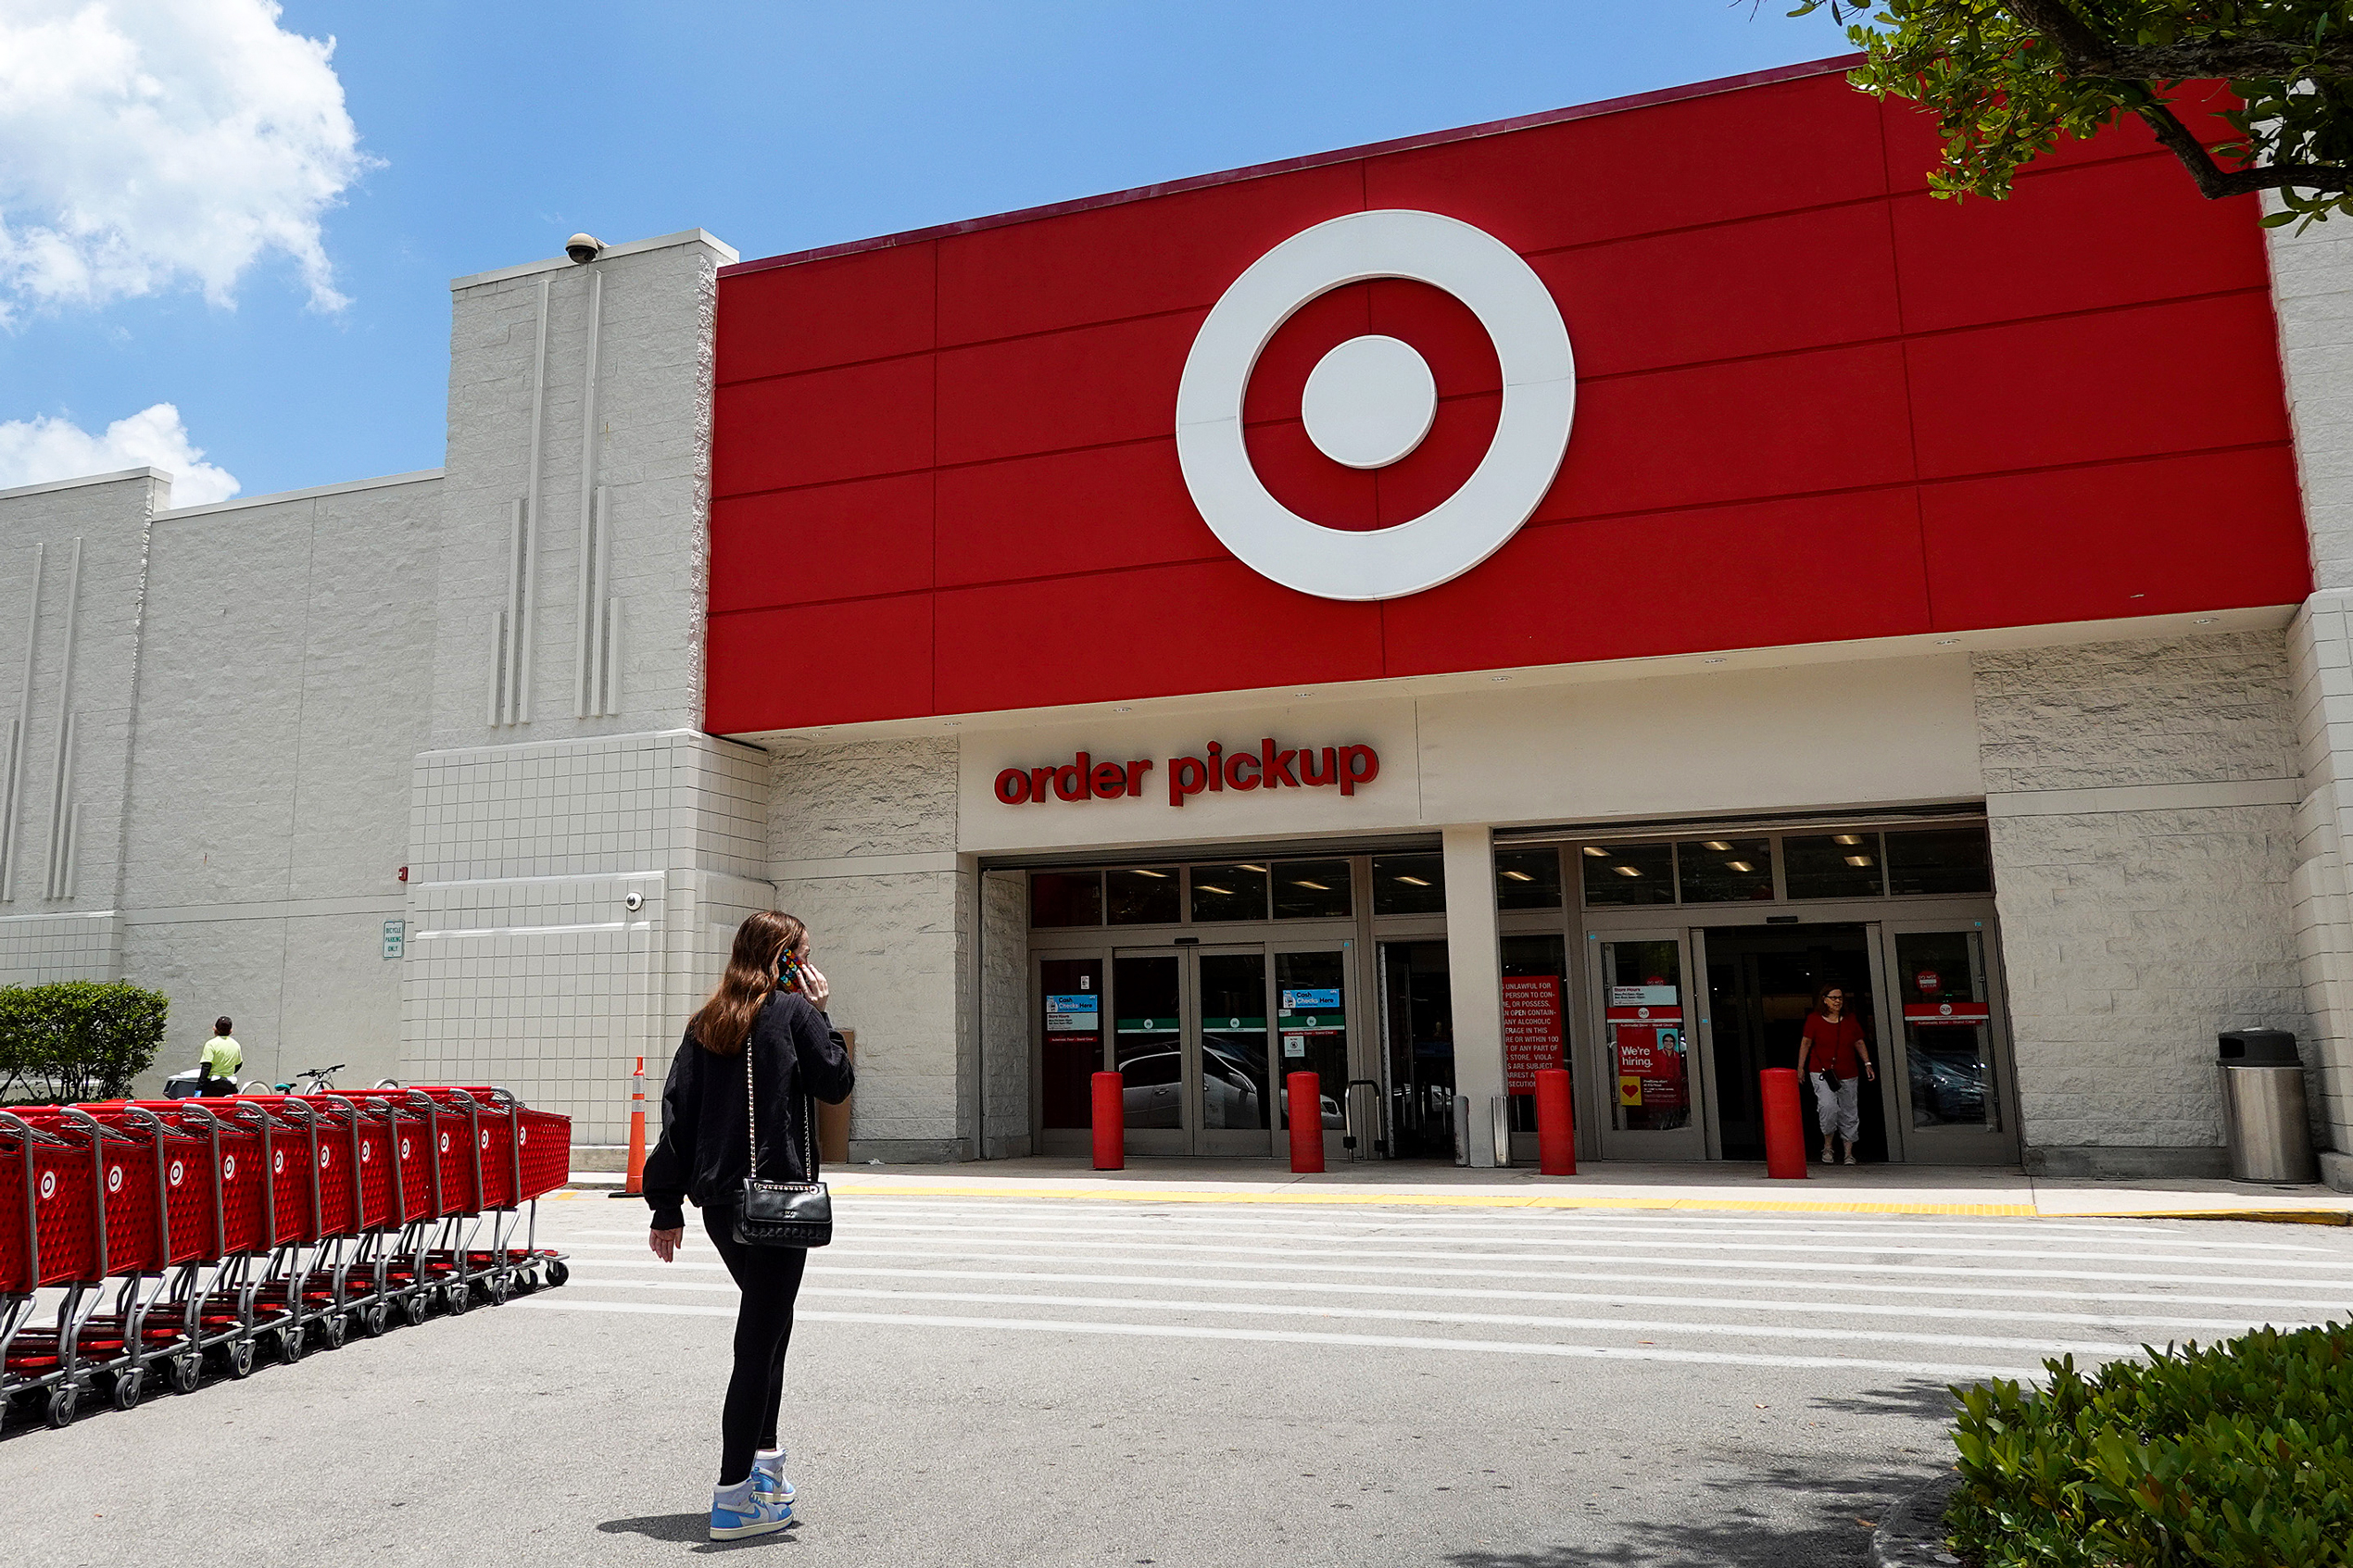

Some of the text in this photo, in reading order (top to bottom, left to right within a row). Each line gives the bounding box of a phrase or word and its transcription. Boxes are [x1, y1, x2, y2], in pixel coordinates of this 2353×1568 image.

[994, 738, 1379, 807] order pickup
[1621, 1046, 1650, 1055] We're
[1622, 1057, 1653, 1068] hiring.
